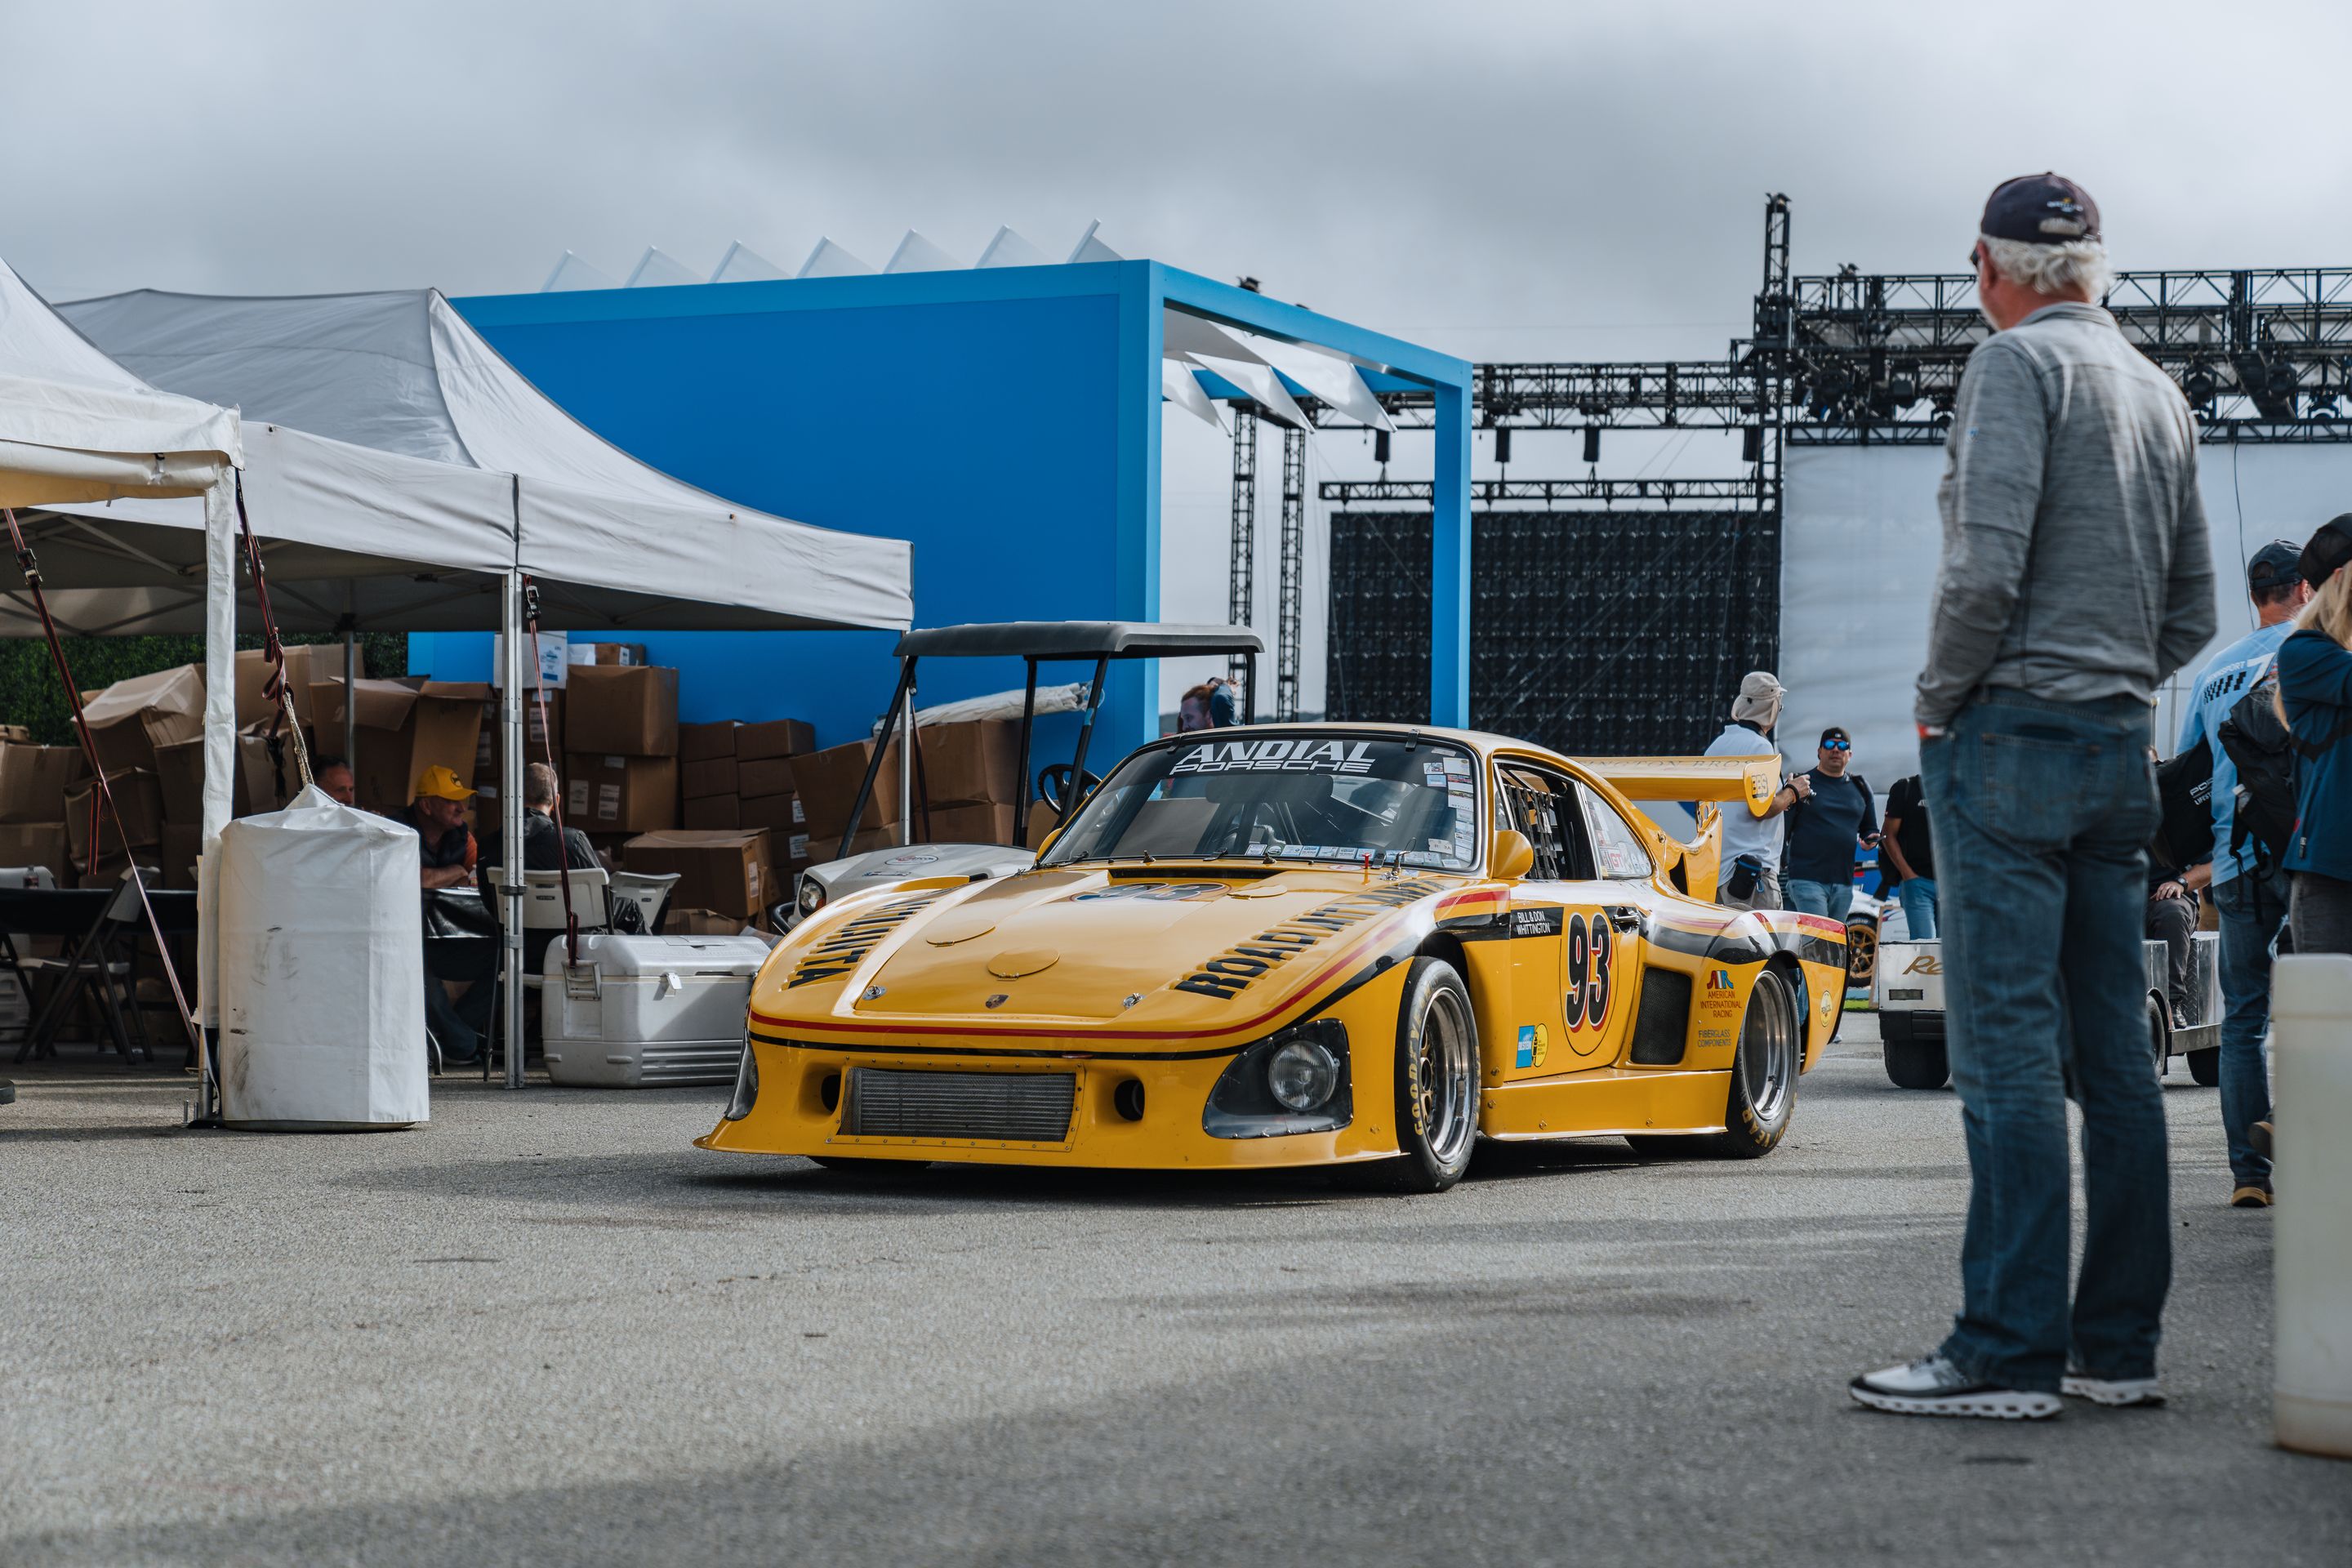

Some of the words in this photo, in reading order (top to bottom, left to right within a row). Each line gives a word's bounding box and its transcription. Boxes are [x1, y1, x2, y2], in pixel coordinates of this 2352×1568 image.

[1175, 740, 1376, 765] ANDIAL
[1169, 760, 1373, 776] PORSCHE
[1076, 882, 1225, 902] 93
[1517, 911, 1530, 924] BILL
[1528, 911, 1535, 922] &
[1533, 911, 1546, 922] DON
[1516, 922, 1551, 936] WHITTINGTON
[1174, 930, 1320, 1000] ROAD
[1566, 911, 1613, 1033] 93
[1706, 969, 1735, 990] AIR
[1708, 991, 1735, 1000] AMERICAN
[1699, 1000, 1743, 1009] INTERNATIONAL
[1713, 1009, 1733, 1018] RACING
[1698, 1029, 1731, 1039] FIBERGLASS
[1697, 1038, 1732, 1048] COMPONENTS
